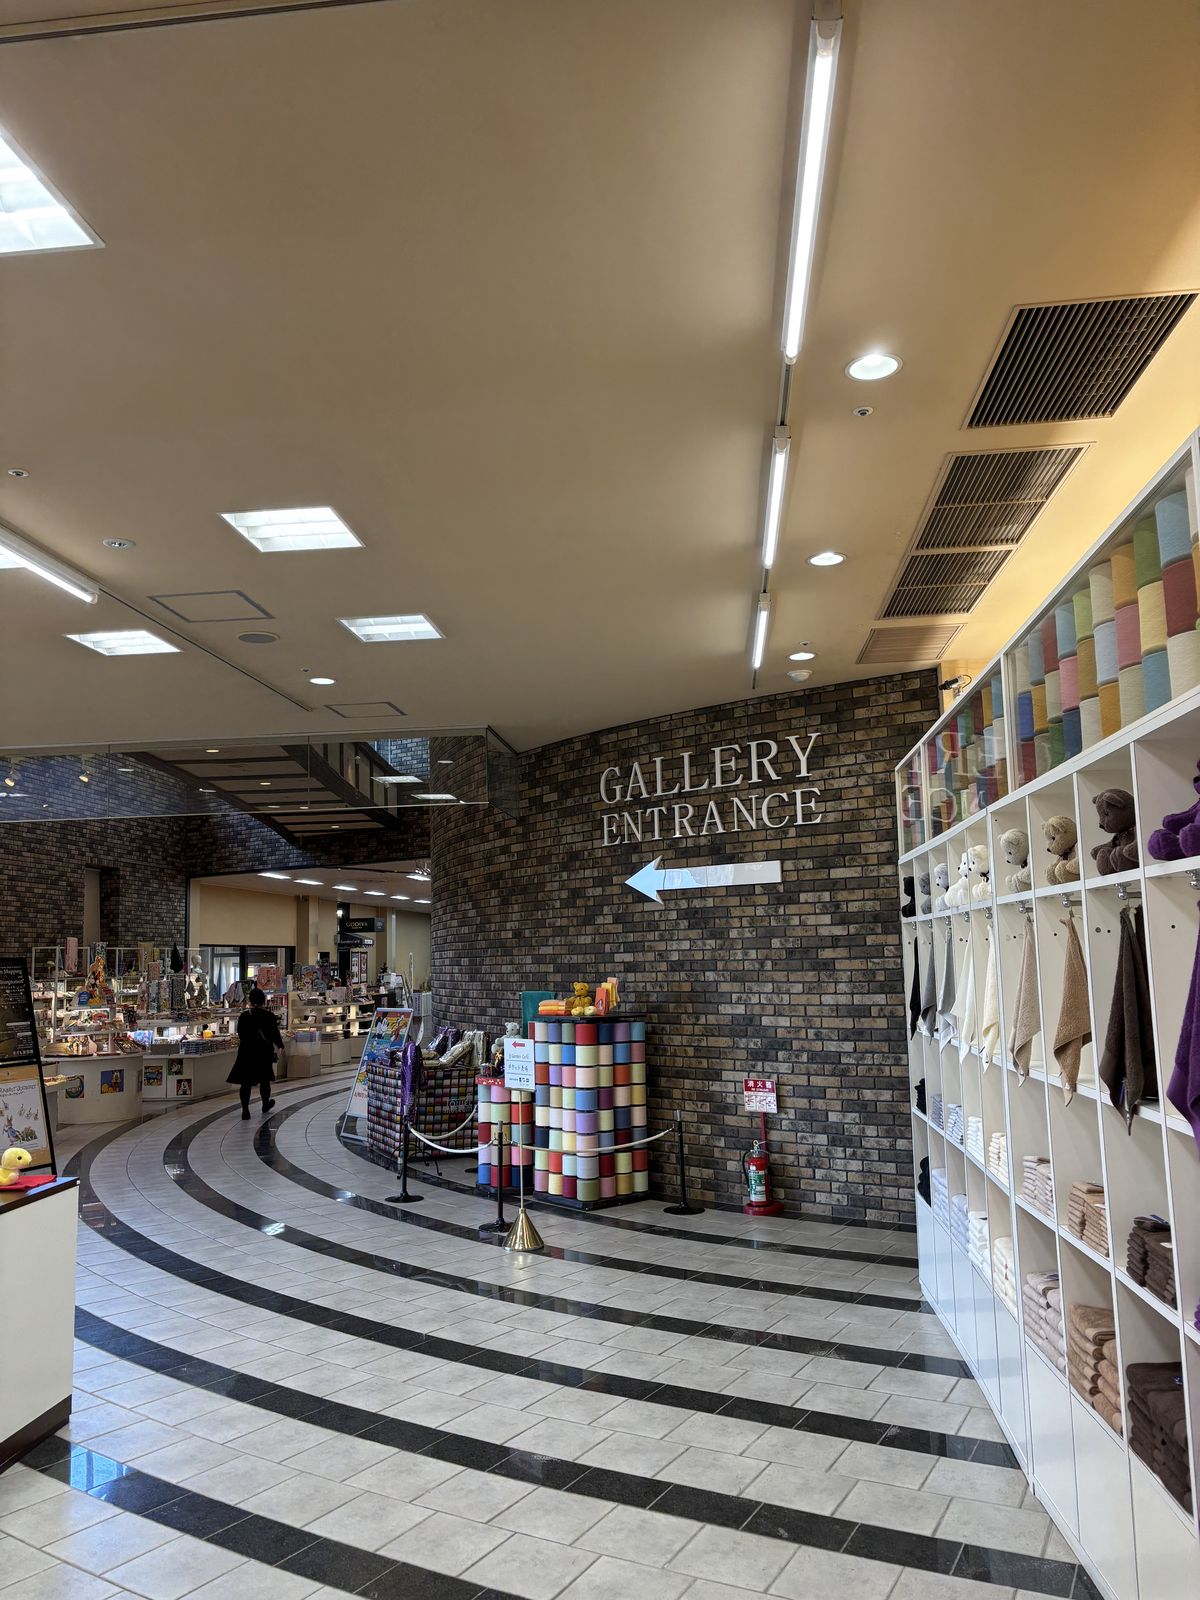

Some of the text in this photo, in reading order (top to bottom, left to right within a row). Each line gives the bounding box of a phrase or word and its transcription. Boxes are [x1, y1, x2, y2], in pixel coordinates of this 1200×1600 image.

[600, 732, 821, 805] GALLERY
[602, 787, 823, 847] ENTRANCE
[747, 1080, 772, 1088] 消火器
